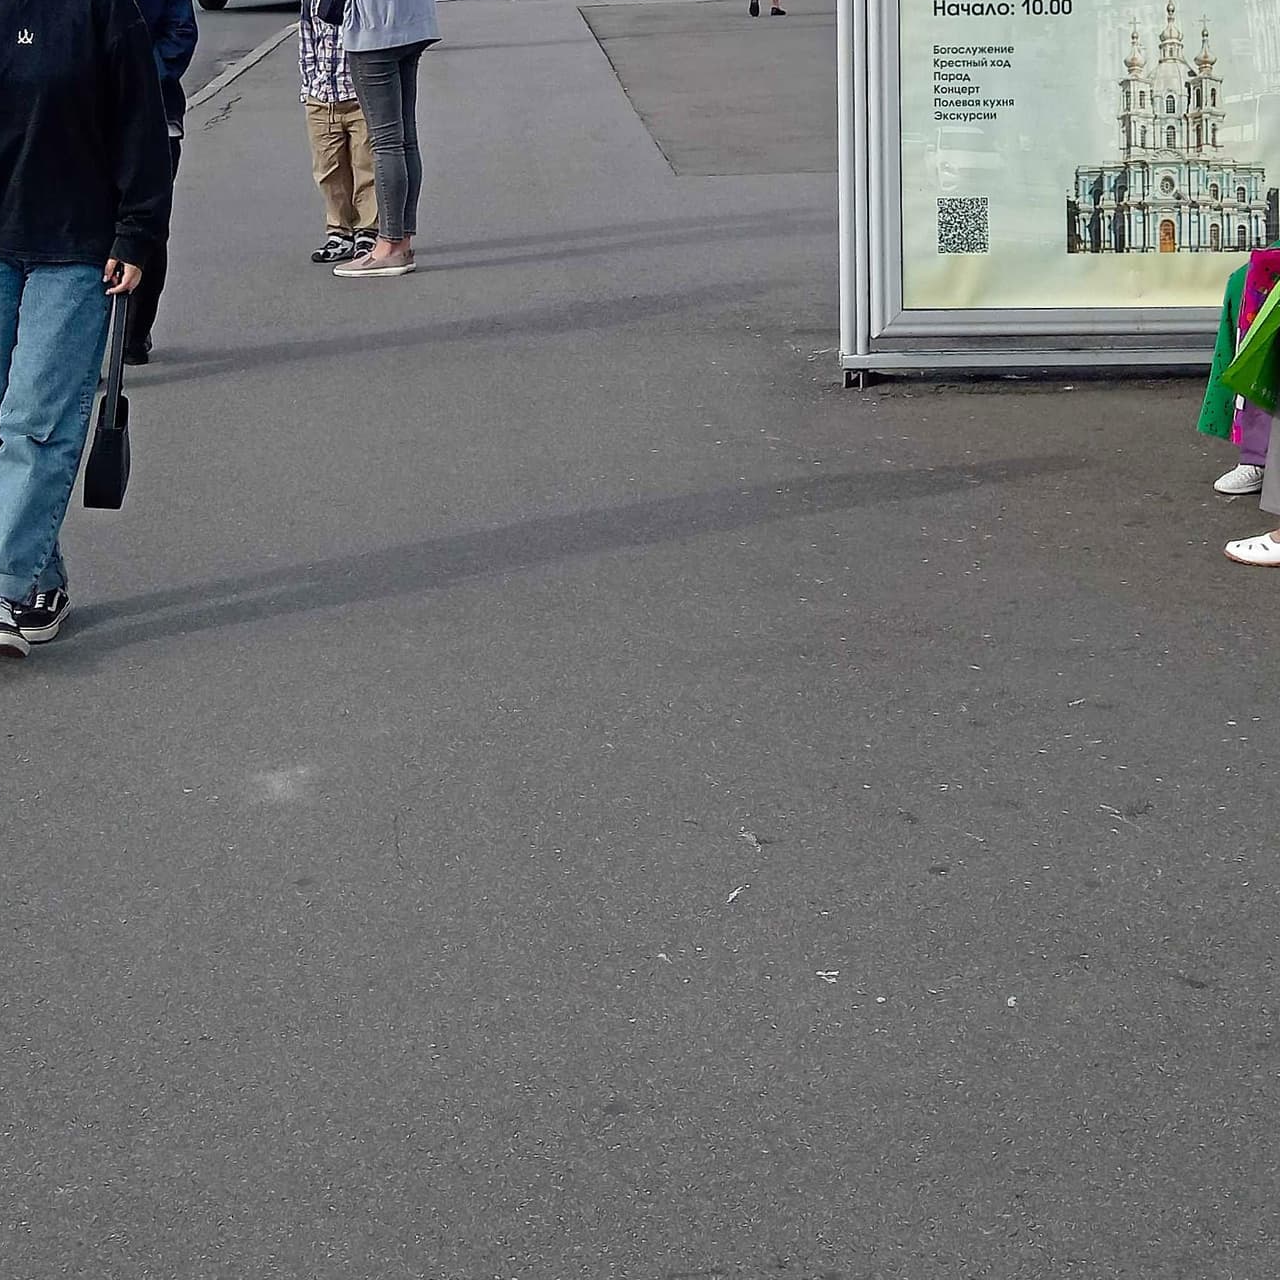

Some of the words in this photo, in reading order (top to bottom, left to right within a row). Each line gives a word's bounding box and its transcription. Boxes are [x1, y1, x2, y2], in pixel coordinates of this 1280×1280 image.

[933, 0, 1015, 17] Начало:
[933, 45, 1015, 56] Богослужение
[933, 57, 988, 70] Крестный
[990, 59, 1012, 69] ход
[933, 71, 971, 82] Парад
[933, 84, 980, 95] Концерт
[933, 97, 981, 108] Полевая
[983, 98, 1015, 108] кухня
[934, 110, 997, 122] Экскурсии
